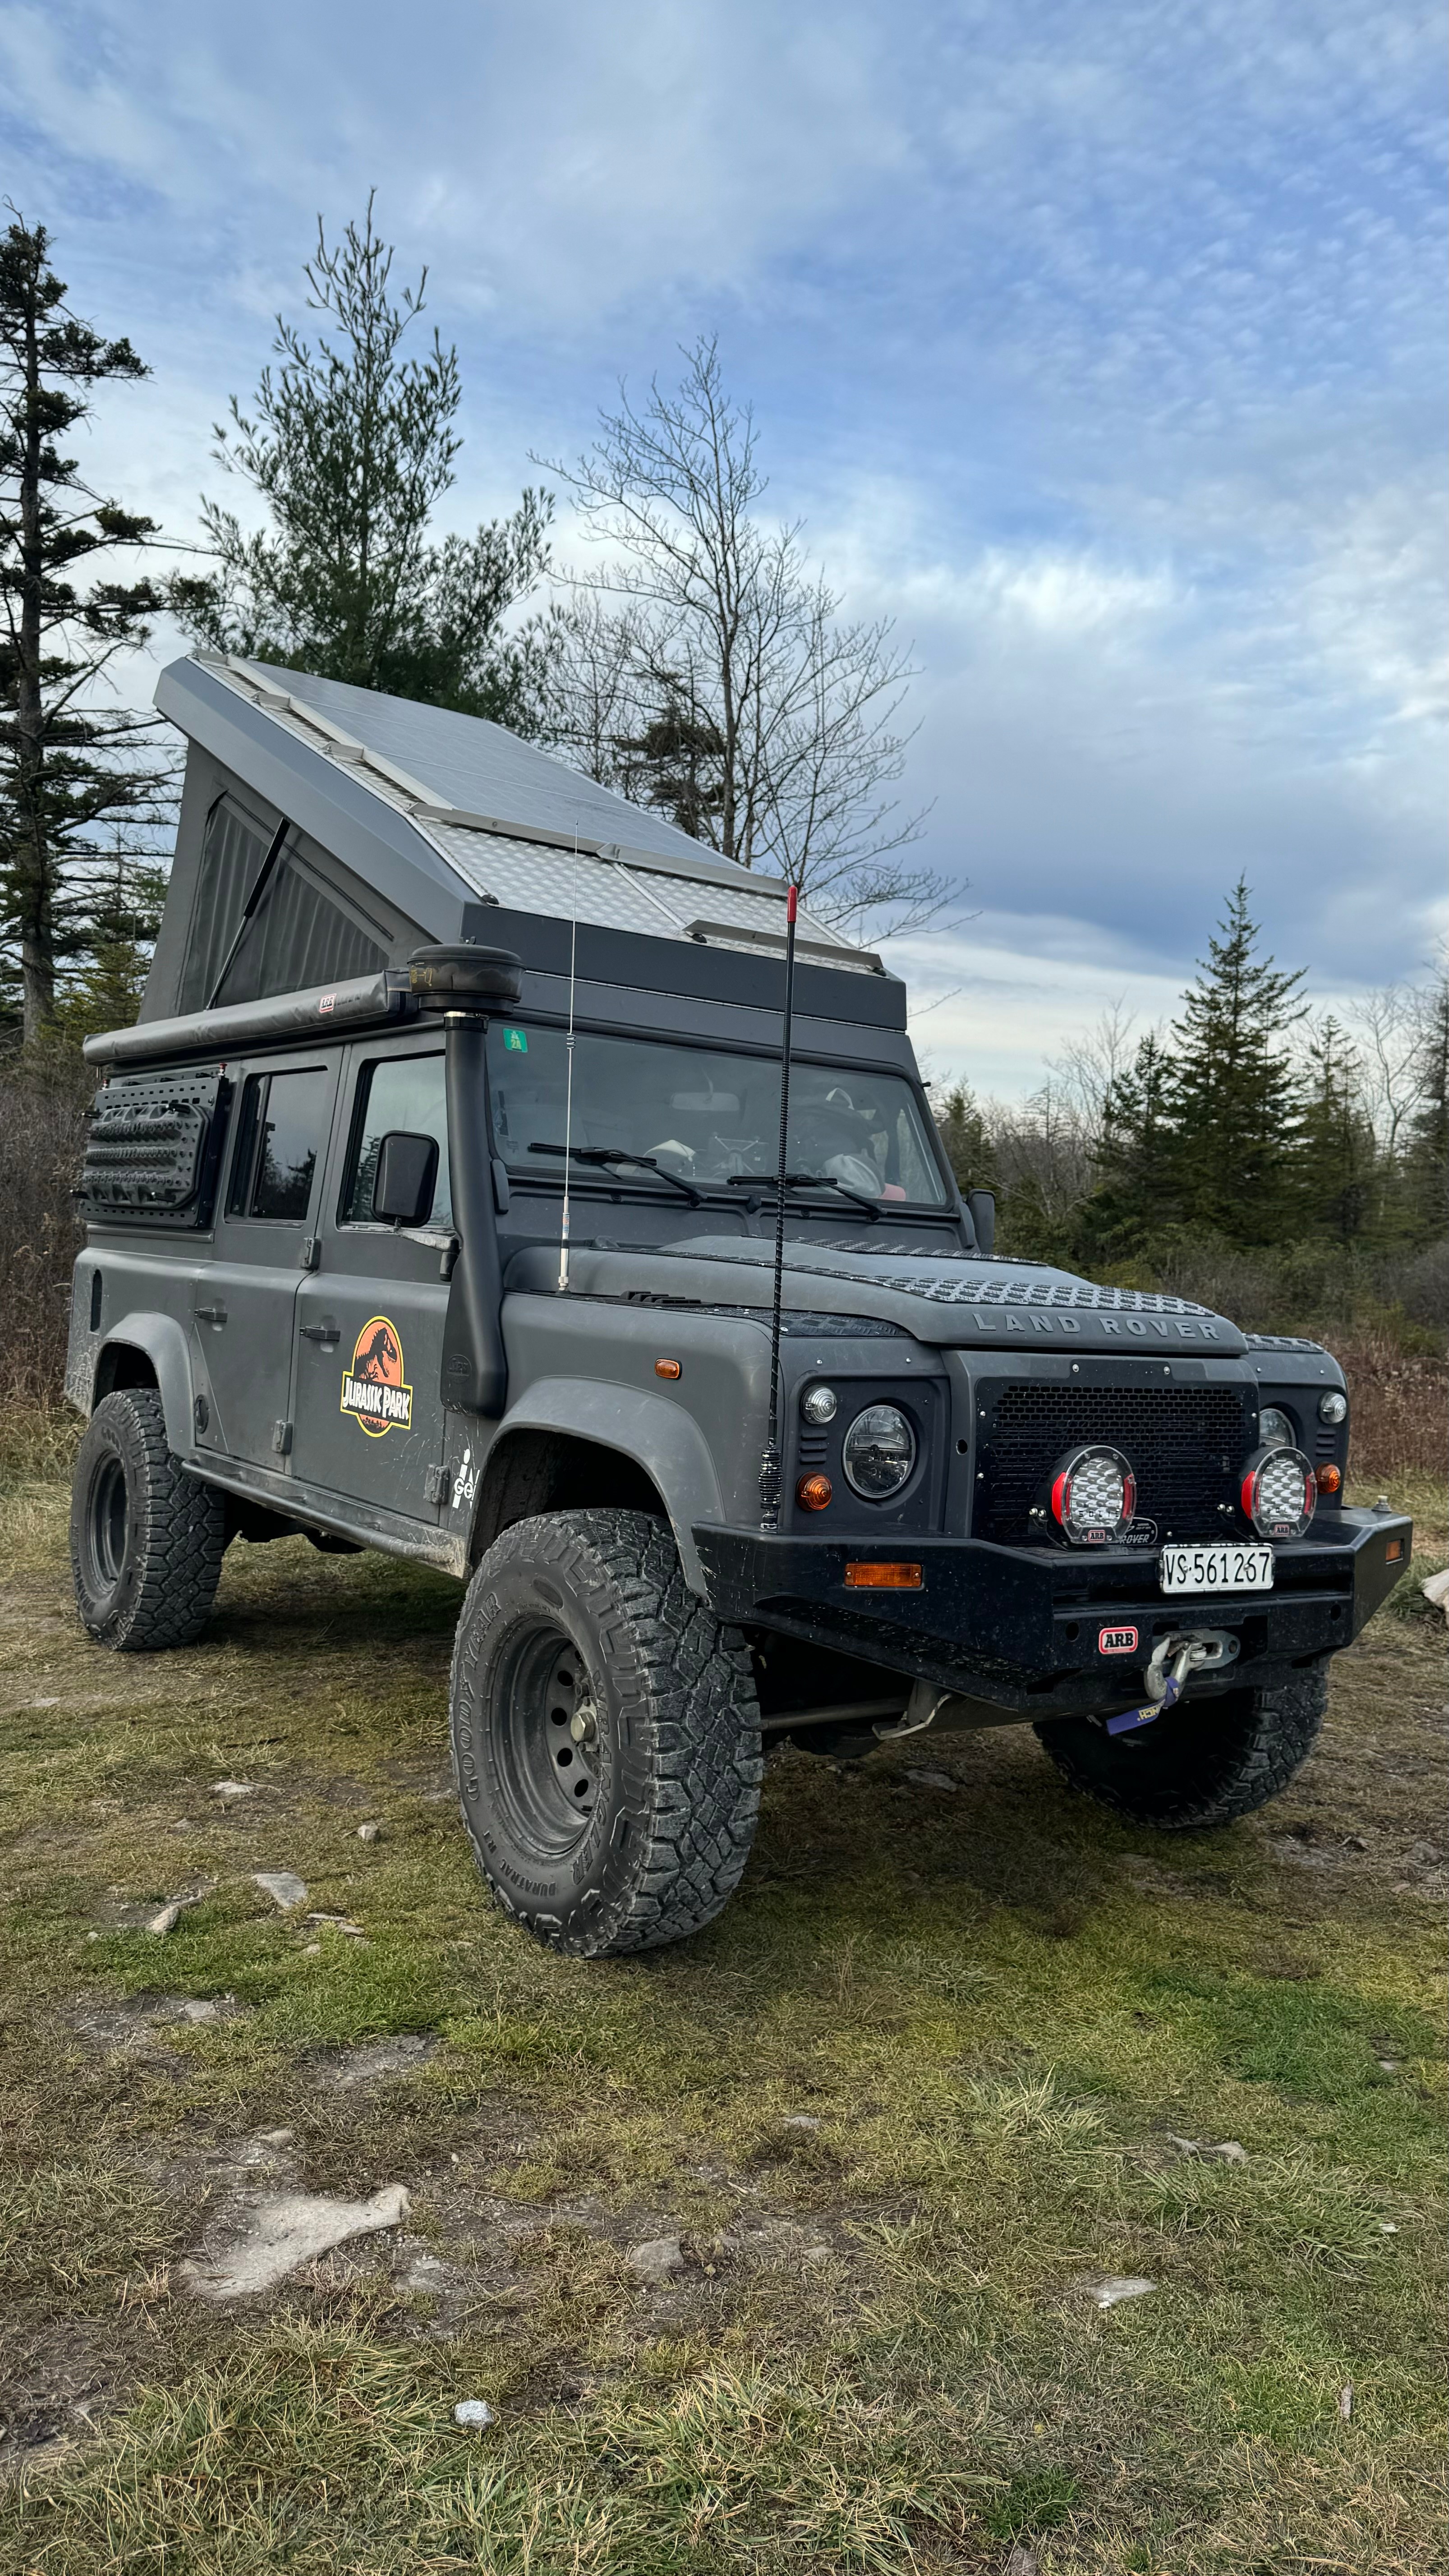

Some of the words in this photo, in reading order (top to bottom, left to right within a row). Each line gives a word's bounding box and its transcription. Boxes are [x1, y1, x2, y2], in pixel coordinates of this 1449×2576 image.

[973, 1313, 1081, 1333] LAND
[1099, 1317, 1220, 1339] ROVER
[342, 1377, 382, 1413] JURASSIC
[382, 1385, 410, 1420] PARK
[1104, 1632, 1134, 1648] ARB
[499, 1858, 557, 1896] DURATRAC
